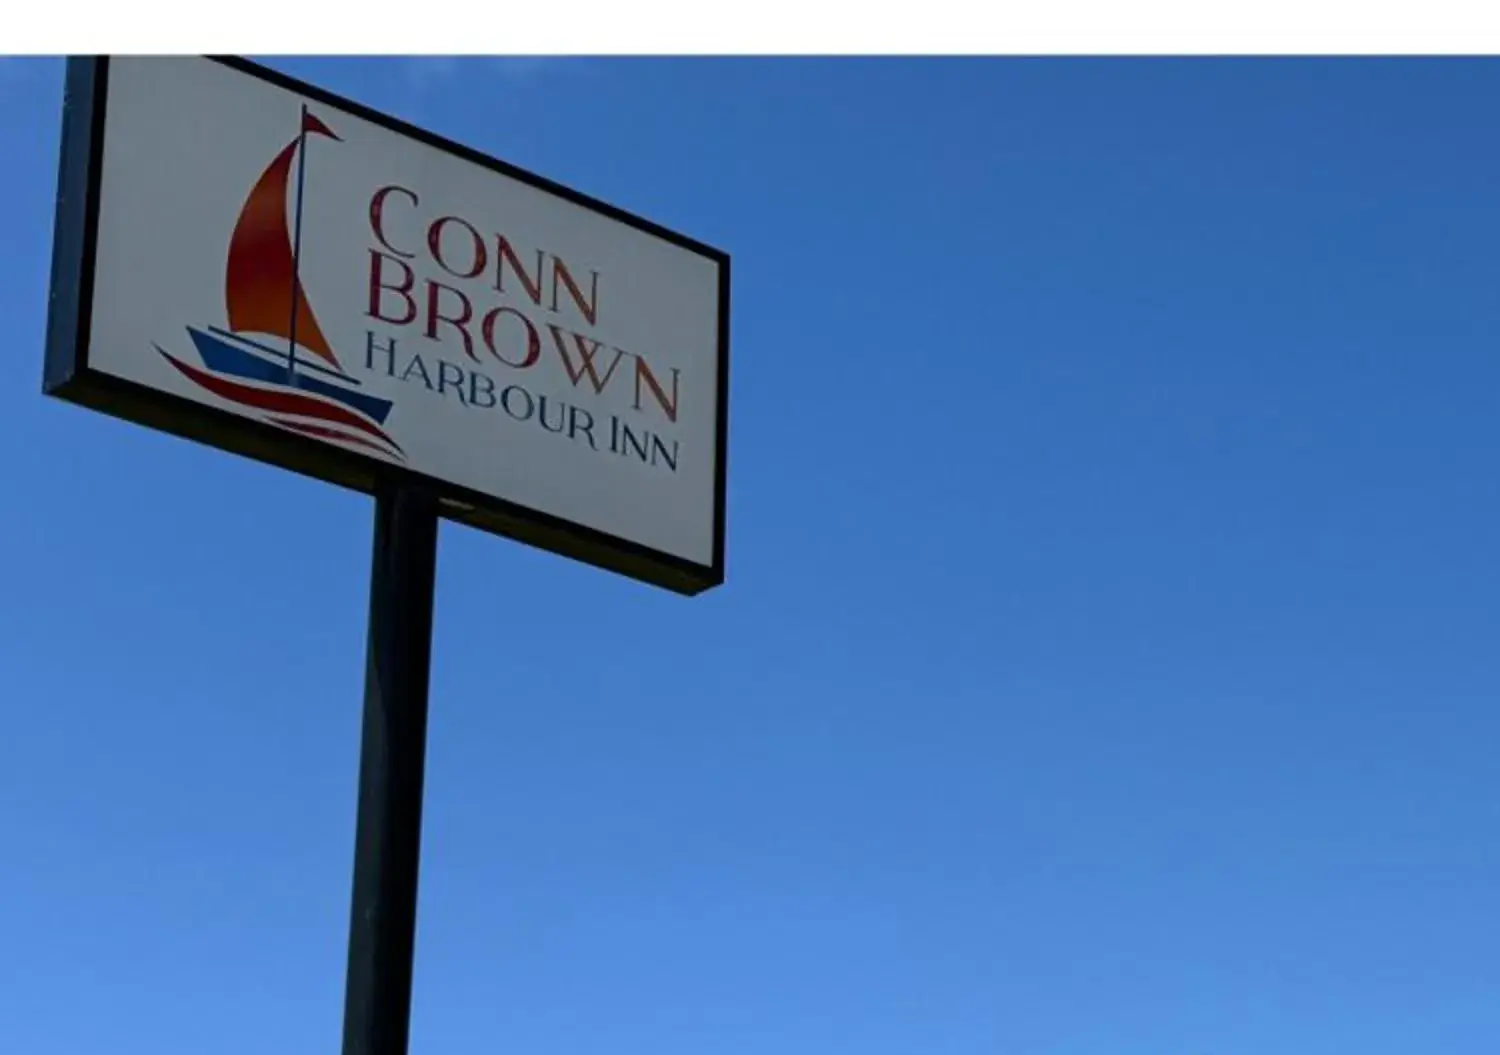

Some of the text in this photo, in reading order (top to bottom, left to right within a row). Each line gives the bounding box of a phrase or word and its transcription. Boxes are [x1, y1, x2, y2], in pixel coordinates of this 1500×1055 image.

[368, 184, 601, 327] CONN
[363, 248, 682, 425] BROWN
[364, 331, 680, 474] HARBOUR INN
